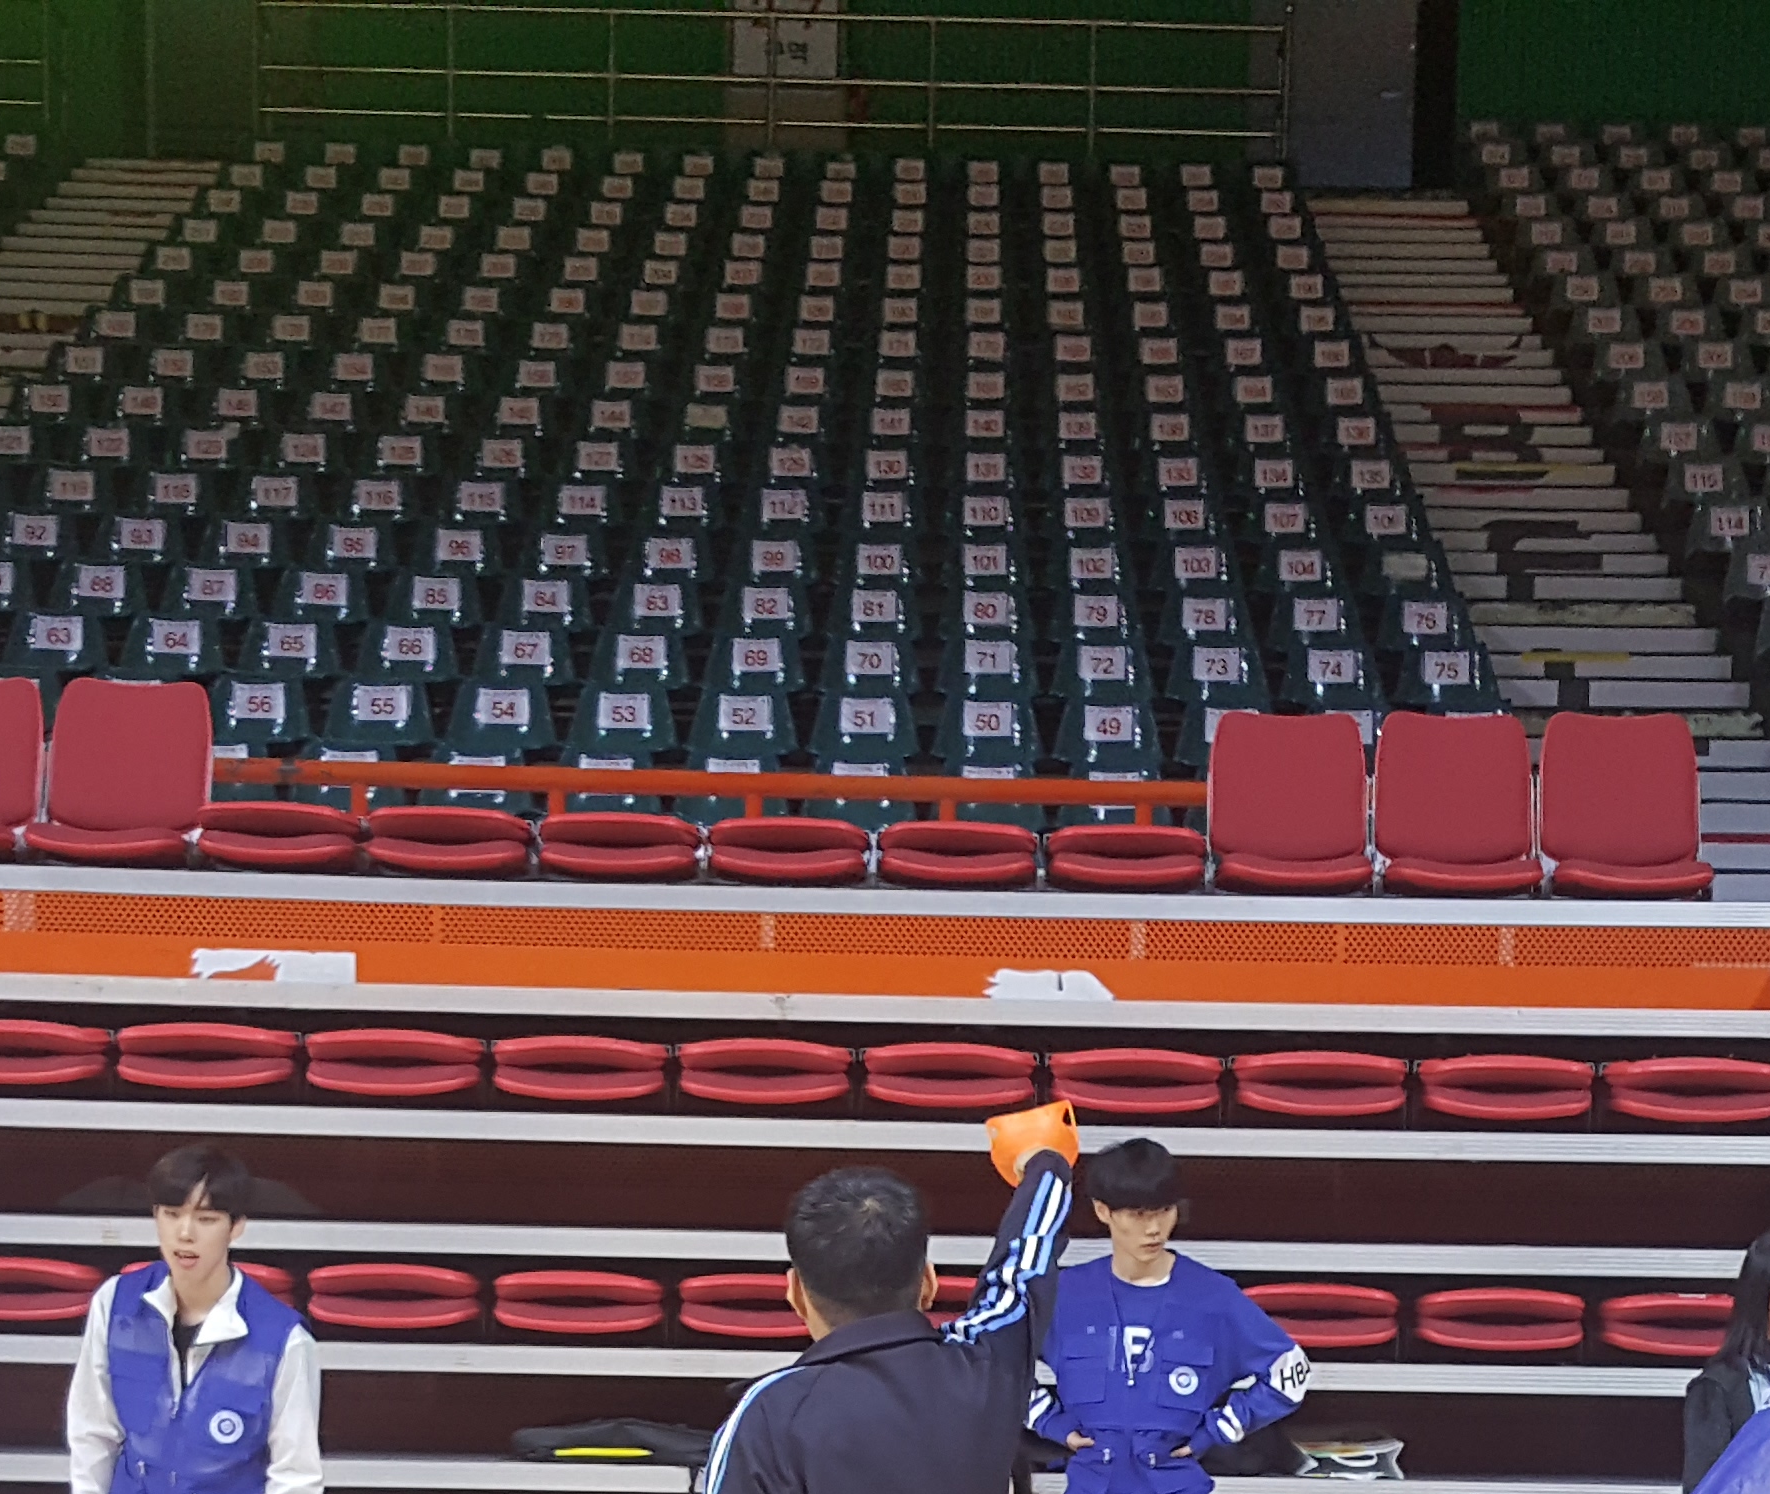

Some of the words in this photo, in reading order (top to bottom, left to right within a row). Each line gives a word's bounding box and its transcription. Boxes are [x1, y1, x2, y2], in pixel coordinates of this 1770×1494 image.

[972, 555, 998, 570] 101
[1078, 558, 1106, 573] 102
[1304, 609, 1326, 625] 77
[46, 627, 71, 644] 63
[164, 632, 188, 649] 64
[398, 638, 422, 655] 66
[514, 642, 538, 658] 67
[629, 646, 653, 664] 68
[744, 650, 767, 666] 69
[858, 652, 882, 669] 70
[977, 652, 996, 668] 71
[1091, 657, 1114, 674] 72
[1206, 658, 1228, 675] 73
[1319, 660, 1342, 677] 74
[1435, 662, 1459, 679] 75
[247, 696, 272, 713] 56
[371, 698, 395, 715] 55
[492, 701, 515, 718] 54
[612, 705, 636, 722] 53
[732, 708, 756, 725] 52
[853, 710, 875, 728] 51
[976, 713, 1000, 731] 50
[1097, 717, 1121, 735] 49
